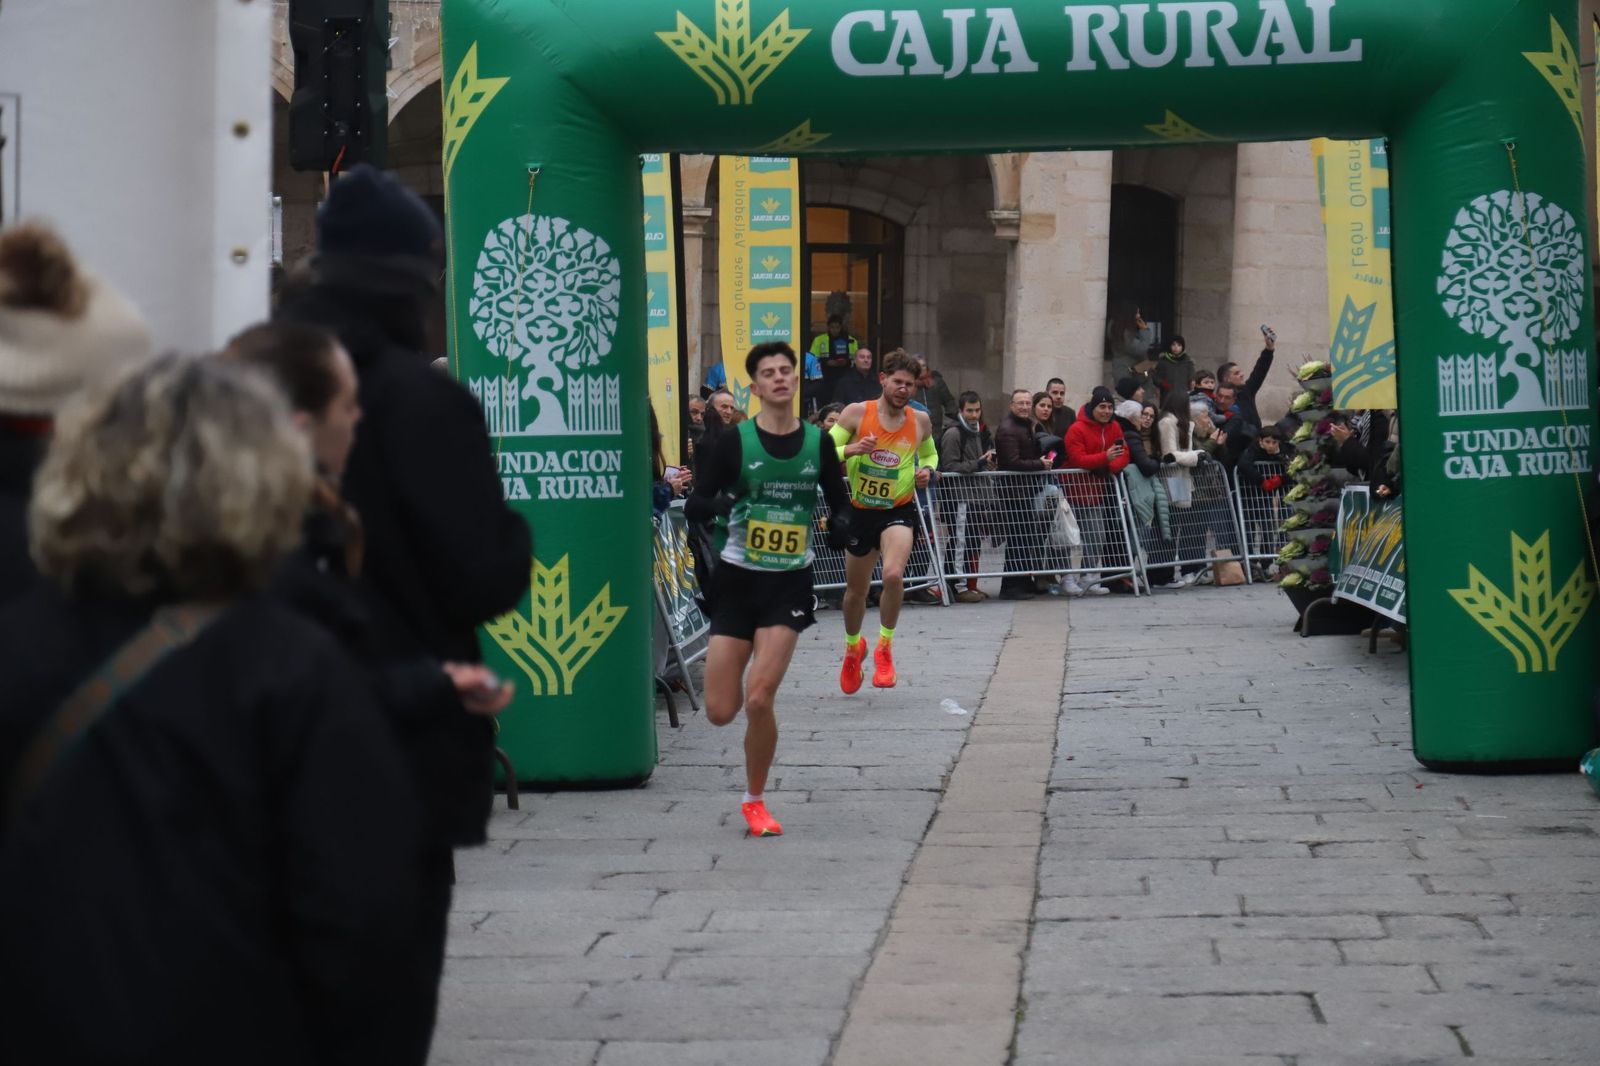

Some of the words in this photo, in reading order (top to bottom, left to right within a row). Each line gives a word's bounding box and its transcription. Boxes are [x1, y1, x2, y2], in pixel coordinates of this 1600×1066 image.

[830, 8, 1039, 79] CAJA
[1064, 0, 1363, 71] RURAL
[1442, 425, 1591, 453] FUNDACION
[497, 450, 623, 474] NDACION
[872, 452, 899, 464] Serrano
[1444, 454, 1512, 480] CAJA
[1517, 450, 1593, 476] RURAL
[501, 477, 531, 500] JA
[538, 475, 624, 499] RURAL
[763, 480, 815, 490] universidad
[772, 490, 793, 500] león
[859, 476, 890, 498] 756
[750, 527, 799, 553] 695
